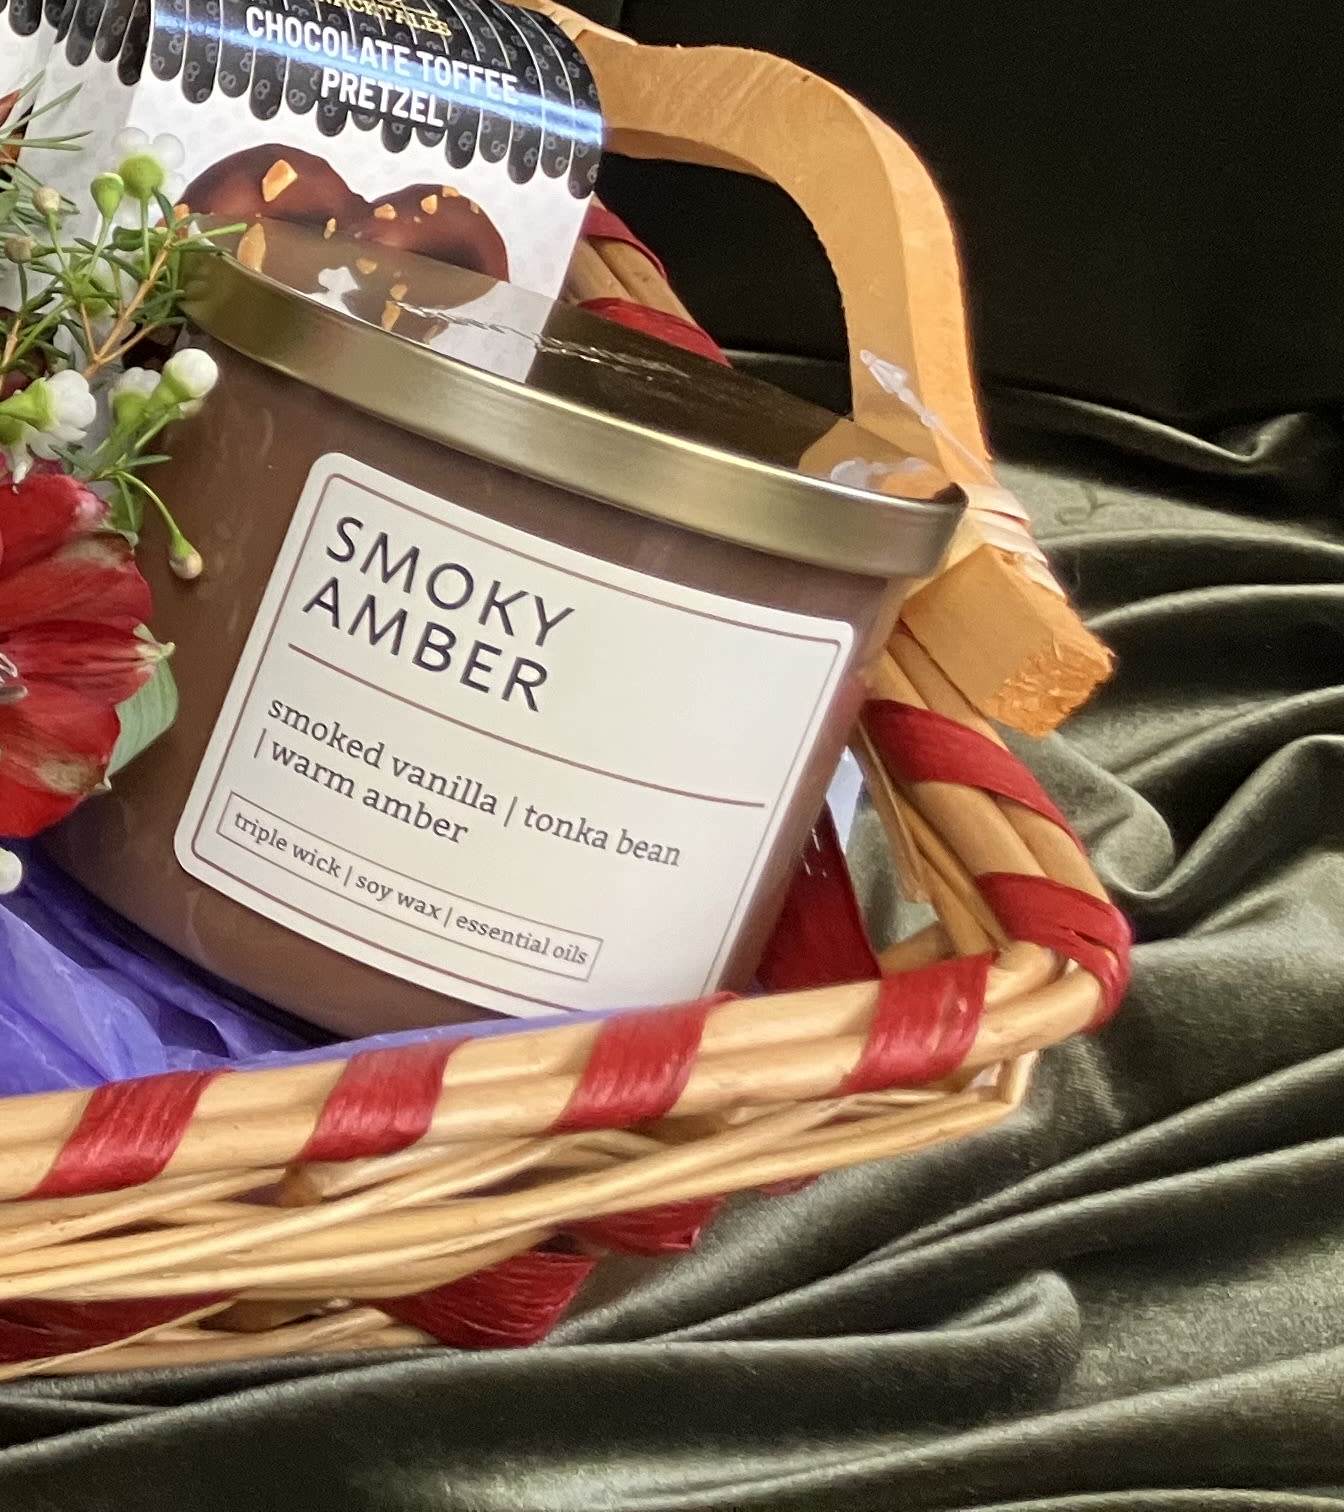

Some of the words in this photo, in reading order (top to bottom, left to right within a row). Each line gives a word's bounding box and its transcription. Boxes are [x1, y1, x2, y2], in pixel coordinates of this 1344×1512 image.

[246, 5, 411, 78] CHOCOLATE
[414, 49, 521, 105] TOFFEE
[321, 67, 446, 128] PRETZEL
[302, 575, 548, 713] AMBER
[325, 516, 575, 648] SMOKY
[267, 699, 385, 770] smoked
[391, 754, 498, 816] vanilla
[523, 804, 609, 850] tonka
[615, 828, 681, 867] bean
[272, 740, 356, 799] warm
[362, 787, 469, 844] amber
[234, 812, 288, 852] triple
[292, 843, 342, 878] wick
[355, 874, 393, 902] soy
[397, 892, 444, 920] wax
[455, 913, 551, 956] essential
[552, 943, 589, 966] oils
